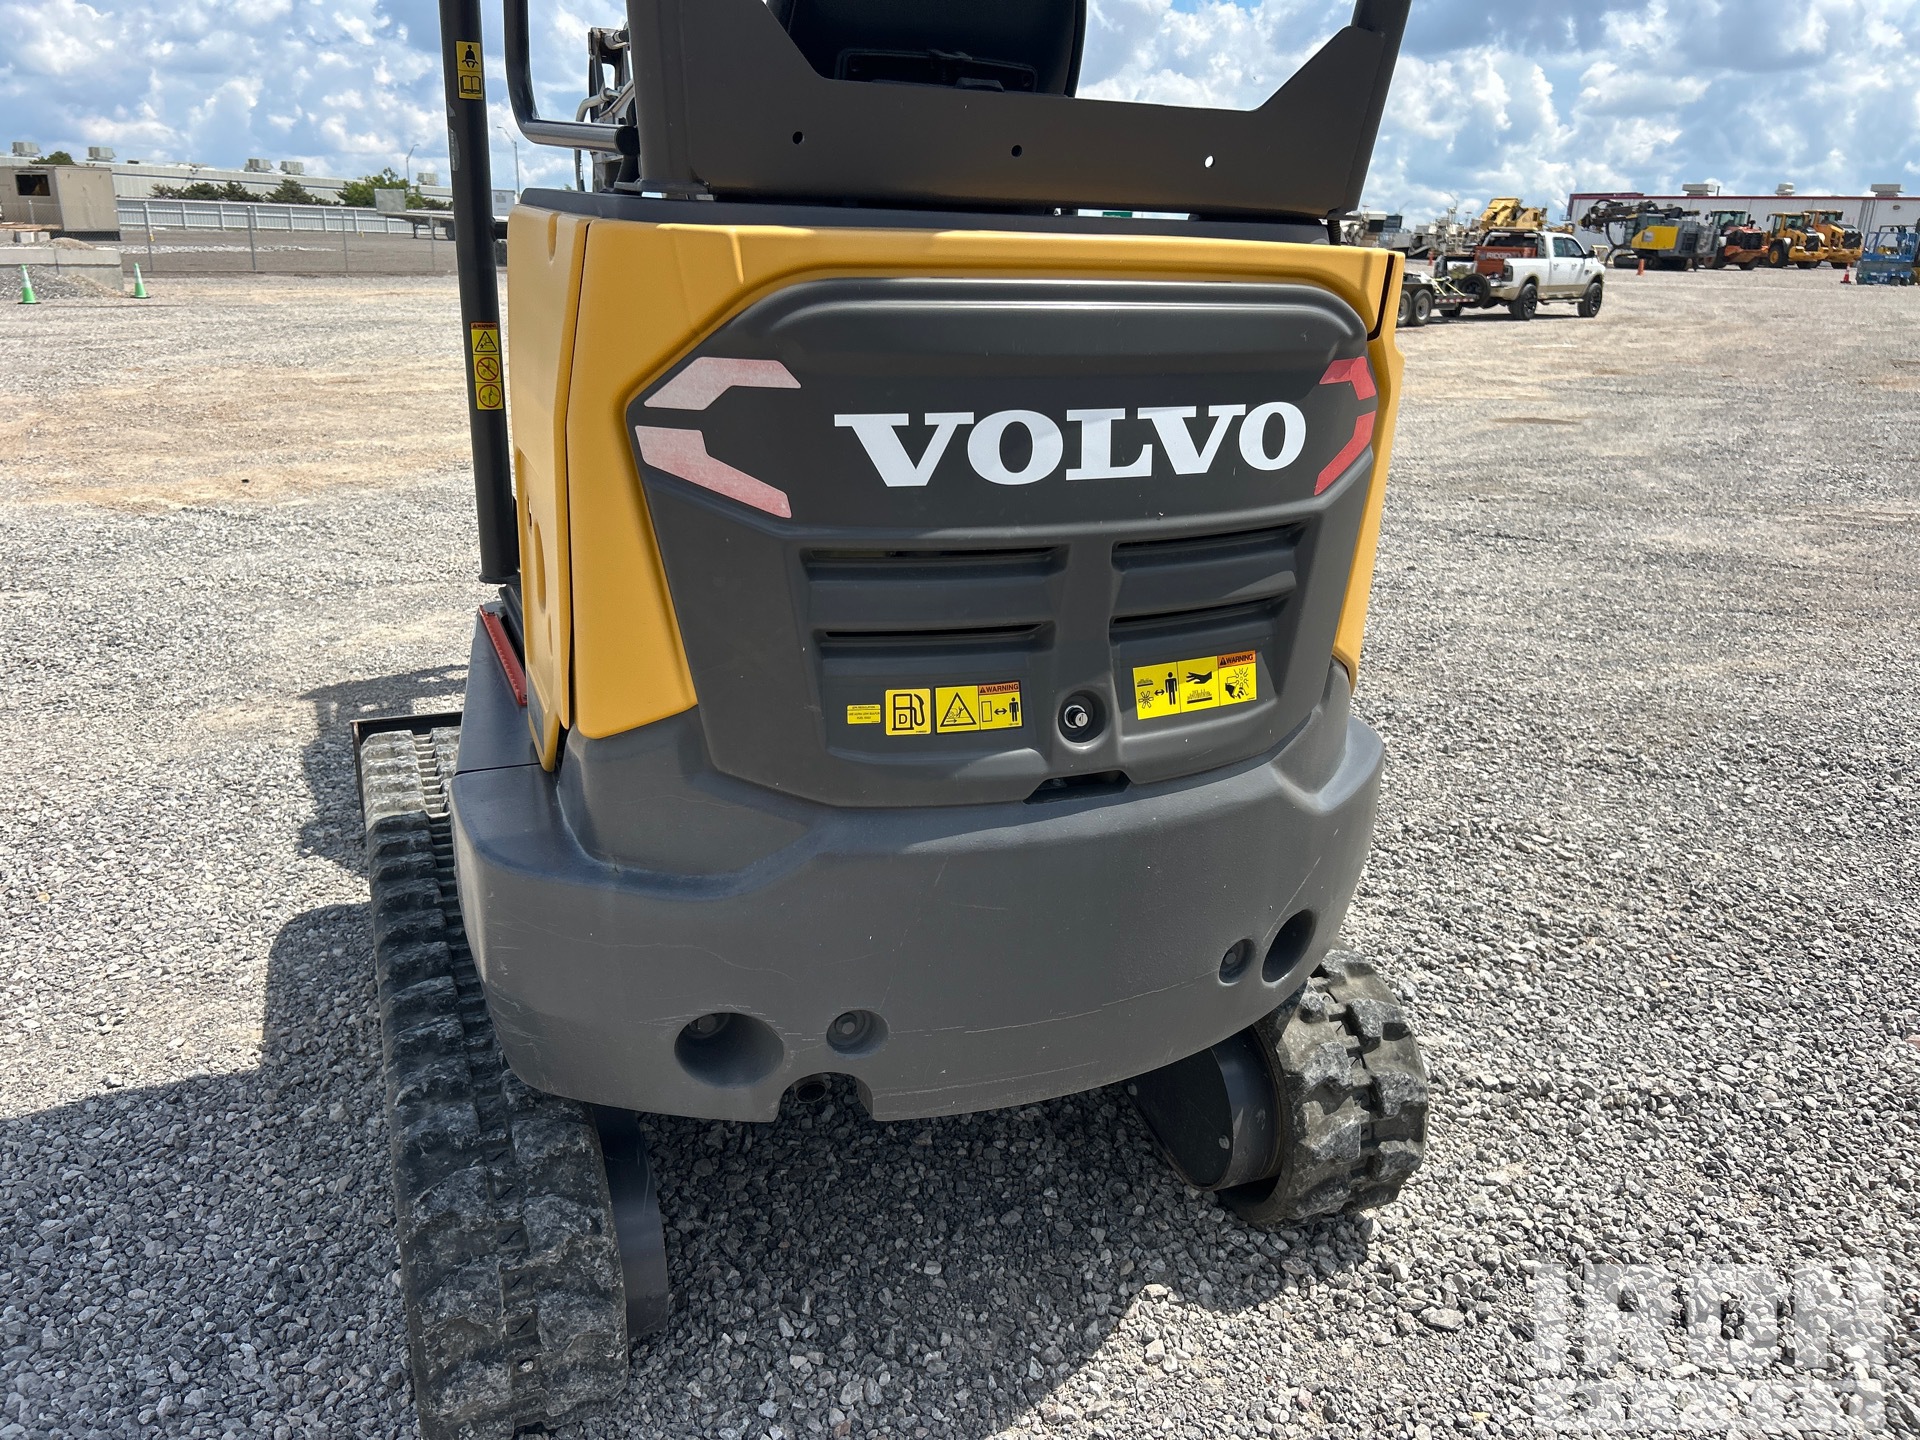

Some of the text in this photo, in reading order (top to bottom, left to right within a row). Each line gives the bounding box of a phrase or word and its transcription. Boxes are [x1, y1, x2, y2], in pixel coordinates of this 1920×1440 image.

[834, 401, 1307, 486] VOLVO
[1225, 653, 1253, 664] WARNING
[985, 683, 1019, 694] WARNING
[899, 714, 907, 724] D
